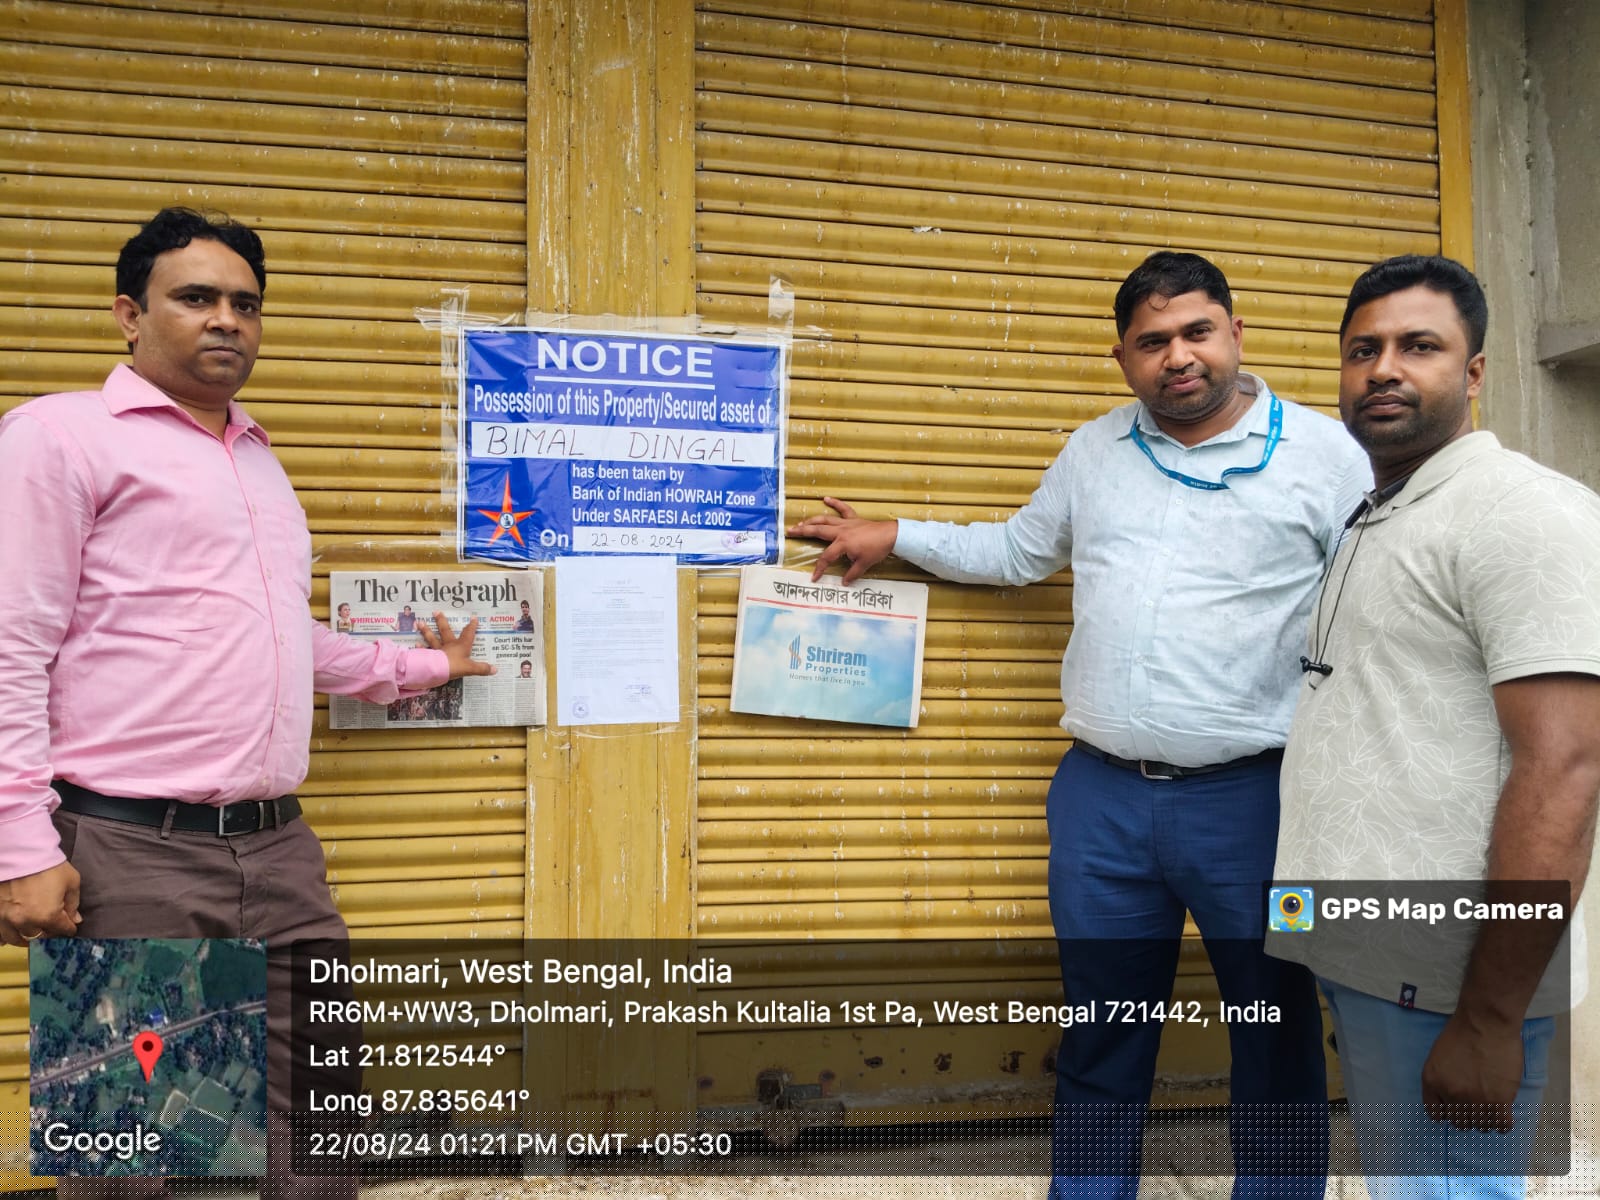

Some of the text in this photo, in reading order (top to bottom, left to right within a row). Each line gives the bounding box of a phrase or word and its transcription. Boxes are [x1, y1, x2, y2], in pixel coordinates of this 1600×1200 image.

[537, 338, 713, 378] NOTICE
[474, 384, 771, 425] Possession of this Property/Secured asset of
[486, 425, 745, 462] BIMAL DINGAL
[572, 463, 685, 485] has been taken by
[572, 485, 756, 506] Bank of Indian HOWRAH Zone
[572, 507, 732, 527] Under SARFAESI Act 2002
[540, 528, 569, 548] On
[354, 578, 518, 608] The Telegraph
[773, 581, 894, 610] আনন্দবাজার পত্রিকা
[489, 615, 515, 623] ACTION
[806, 645, 867, 666] Shriram
[805, 663, 867, 677] Properties
